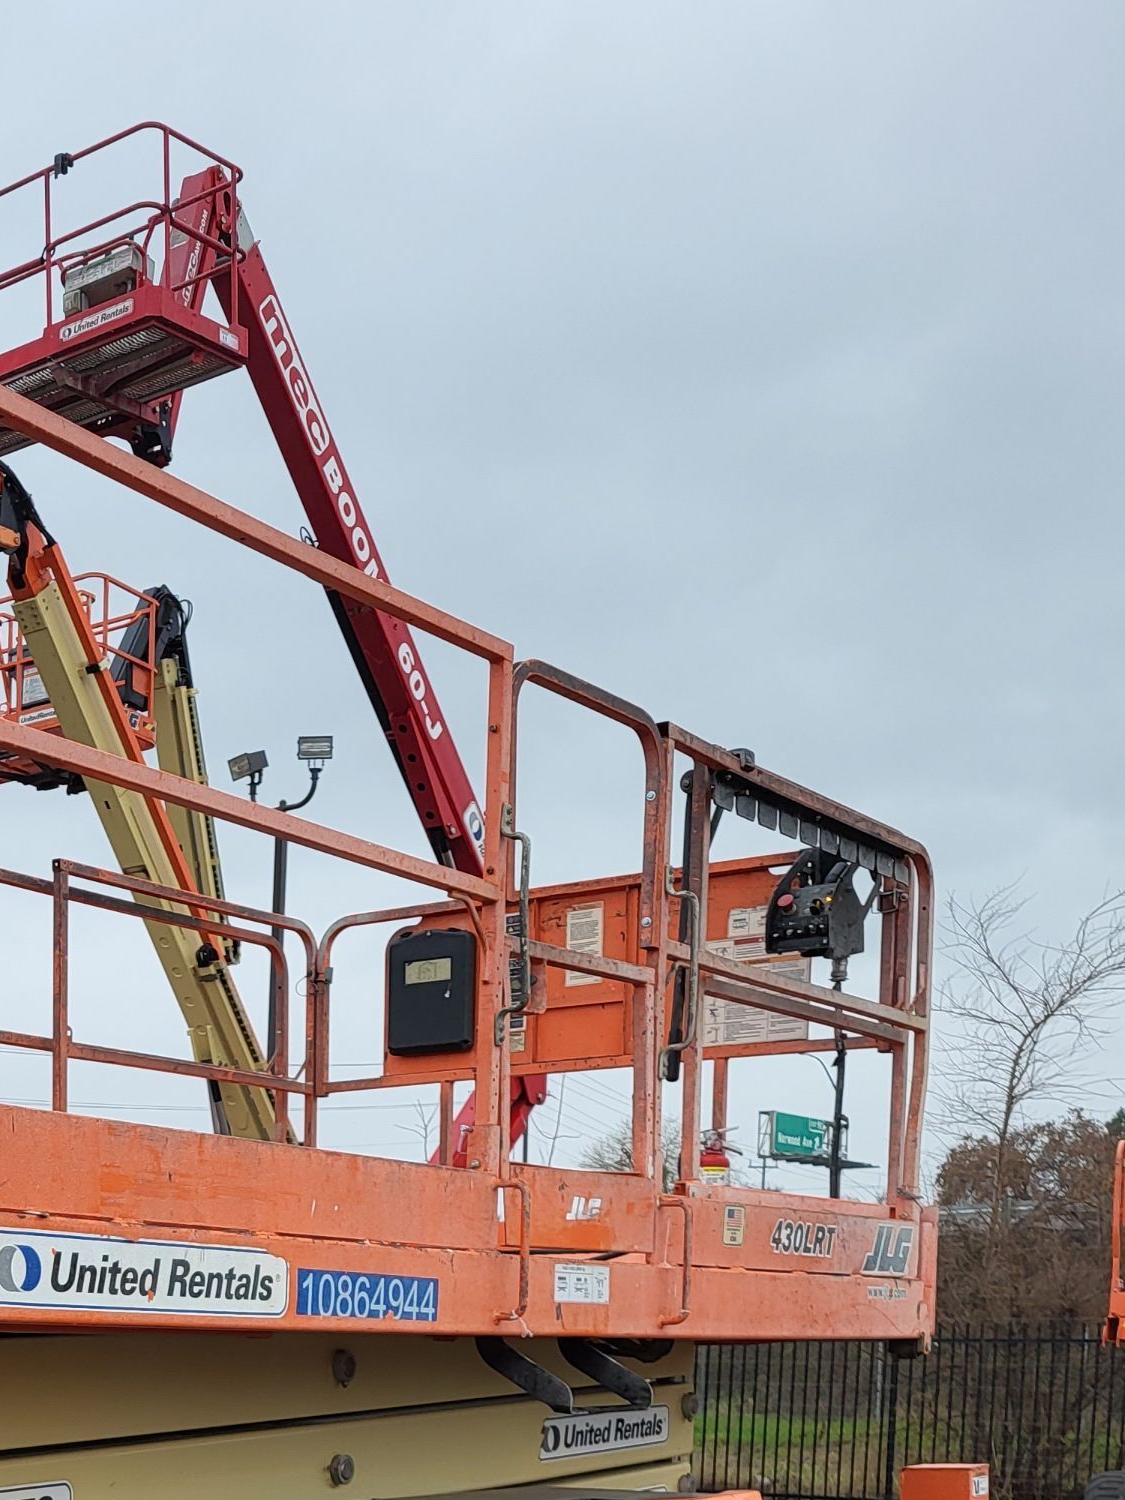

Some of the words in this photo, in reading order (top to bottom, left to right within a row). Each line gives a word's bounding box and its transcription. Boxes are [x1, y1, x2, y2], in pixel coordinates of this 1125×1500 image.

[73, 311, 100, 334] United
[100, 303, 130, 323] Rentals
[397, 641, 443, 740] 60-J
[770, 1217, 837, 1259] 430LRT
[861, 1223, 916, 1279] JLG
[50, 1251, 161, 1299] United
[167, 1258, 274, 1302] Rentals
[302, 1272, 436, 1322] 10864944
[563, 1418, 611, 1449] United
[613, 1413, 663, 1442] Rentals
